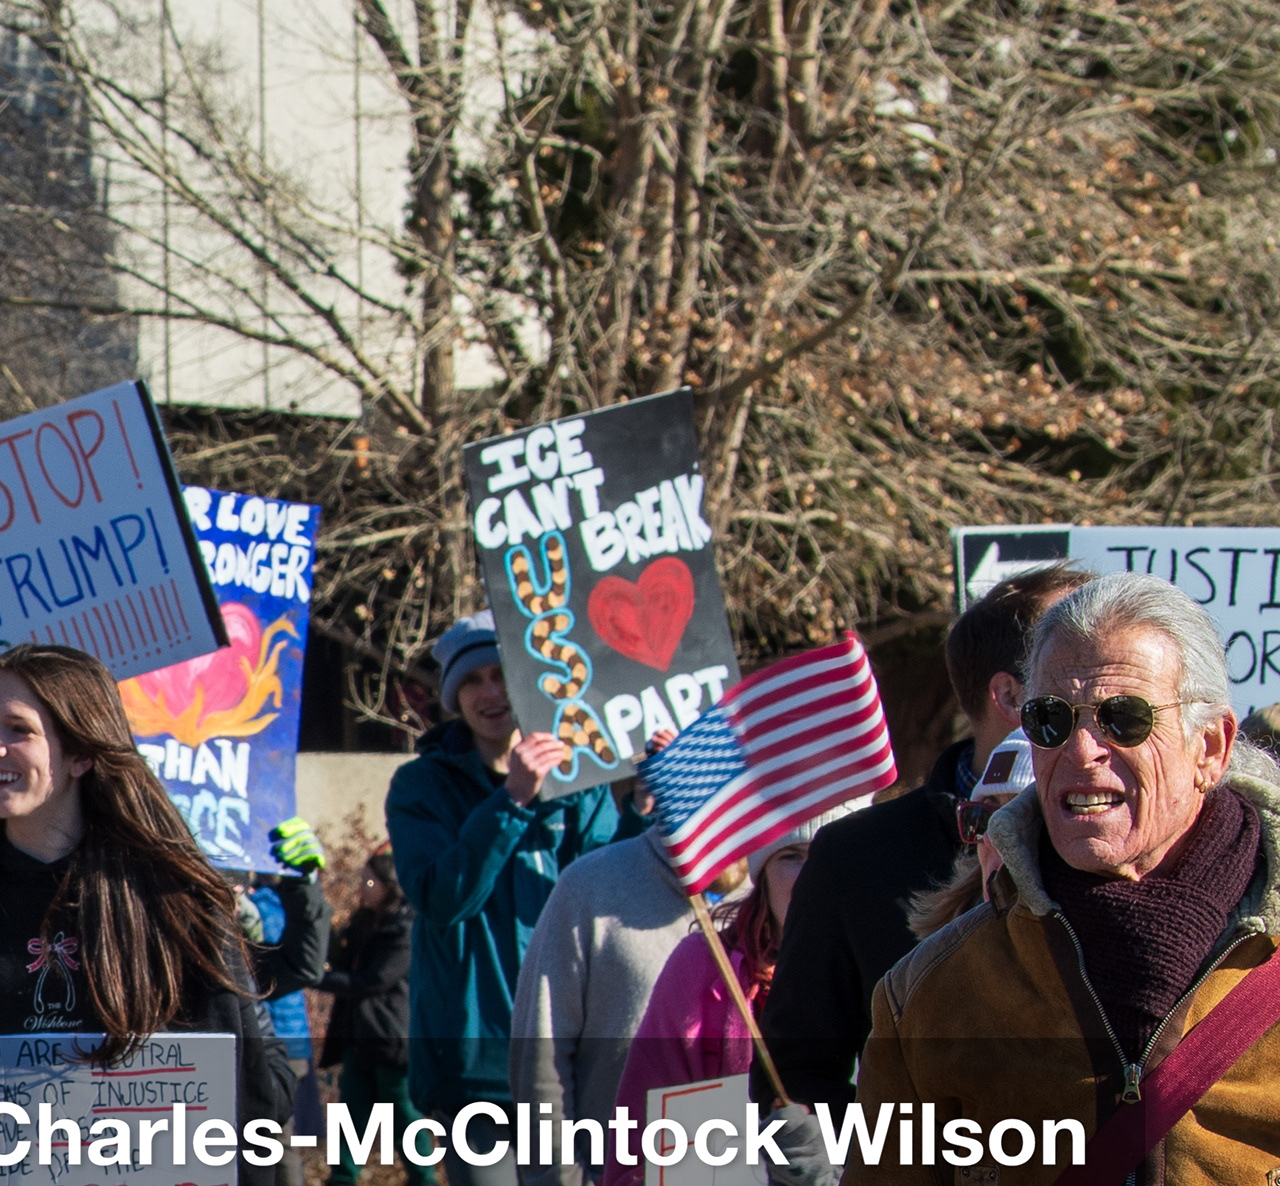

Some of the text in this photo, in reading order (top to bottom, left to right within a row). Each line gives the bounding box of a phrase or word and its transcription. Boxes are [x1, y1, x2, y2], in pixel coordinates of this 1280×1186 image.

[480, 419, 593, 492] ICE
[216, 497, 312, 548] LOVE
[474, 467, 605, 549] CAN'T
[24, 1011, 83, 1031] Wishbone
[16, 1039, 66, 1068] ARE
[43, 1080, 76, 1108] OF
[90, 1081, 210, 1108] INJUSTICE
